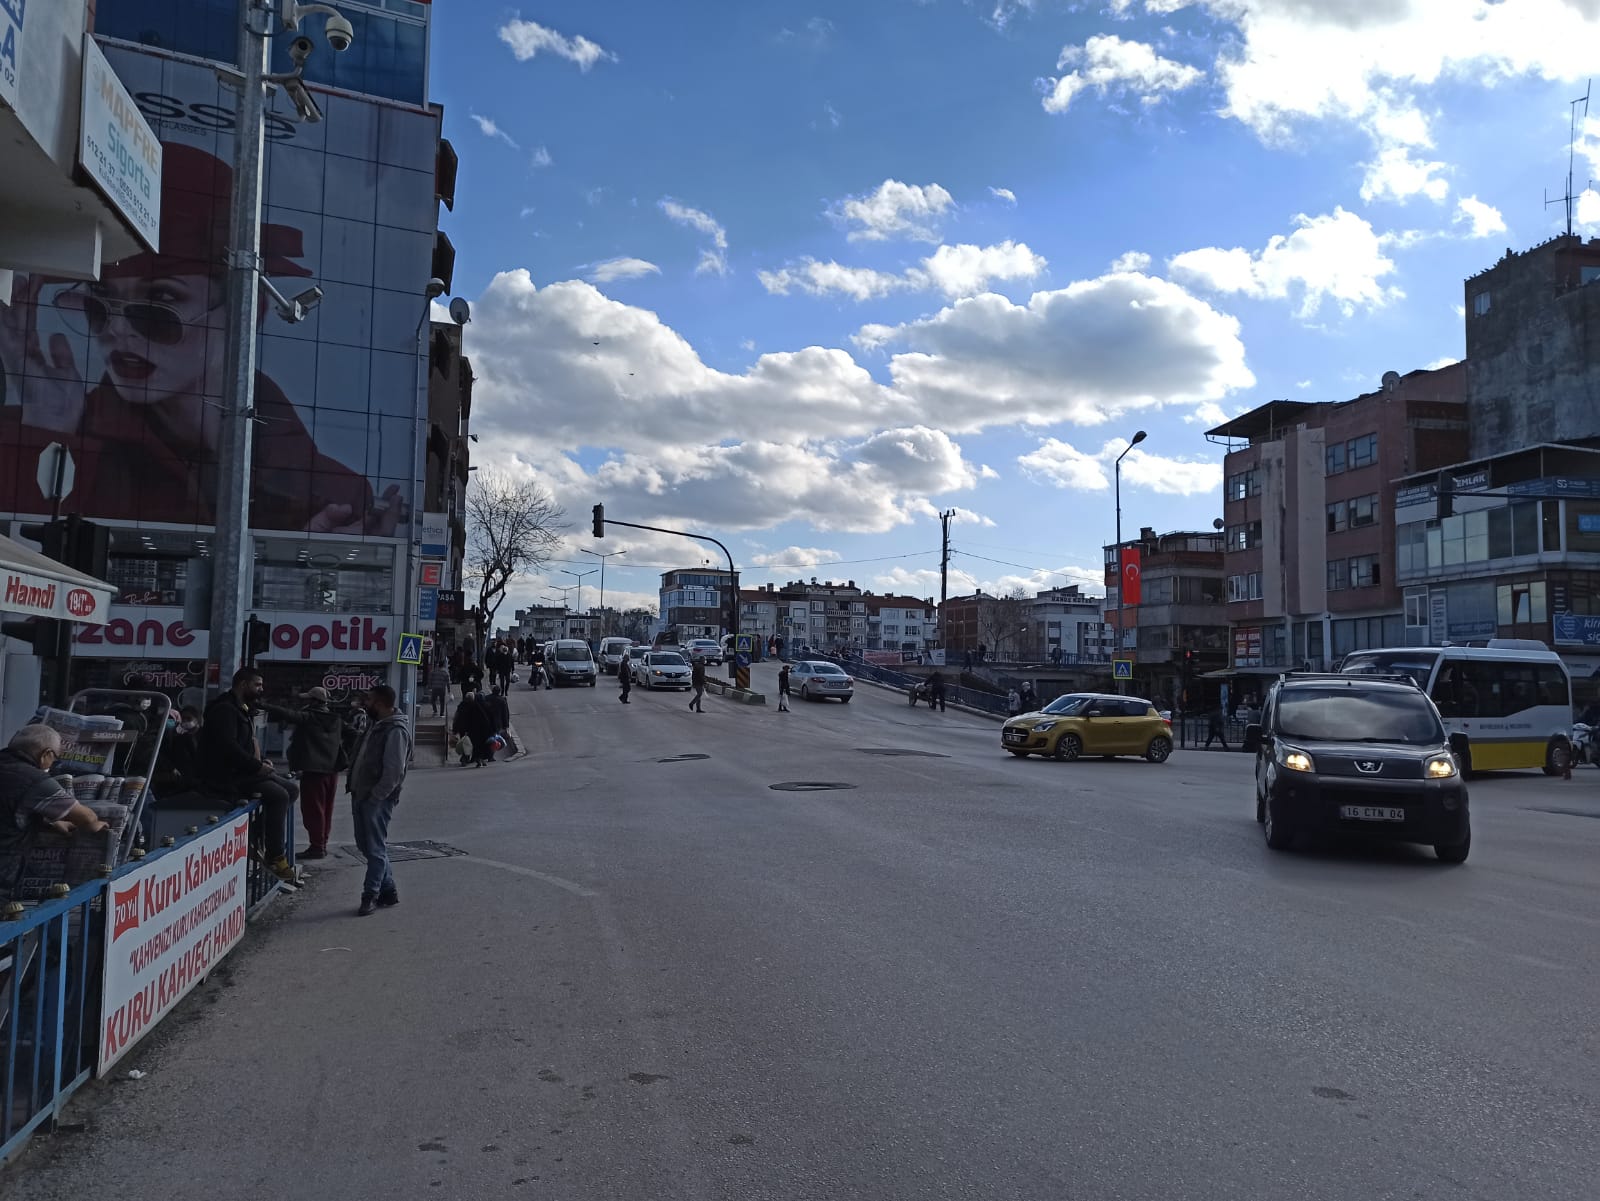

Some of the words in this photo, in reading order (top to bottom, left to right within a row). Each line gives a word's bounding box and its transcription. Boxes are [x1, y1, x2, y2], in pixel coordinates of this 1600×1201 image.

[100, 75, 158, 175] MAPFRE
[107, 121, 151, 201] Sigorta
[1456, 474, 1484, 487] EMLAK
[5, 575, 57, 610] Hamdi
[272, 616, 387, 659] optik
[1348, 807, 1359, 817] 16
[1364, 808, 1385, 818] CTN
[1390, 809, 1403, 819] 04
[144, 871, 182, 922] Kuru
[184, 832, 234, 896] Kahvede
[114, 901, 126, 928] 70
[171, 909, 190, 946] KURU
[104, 979, 155, 1064] KURU
